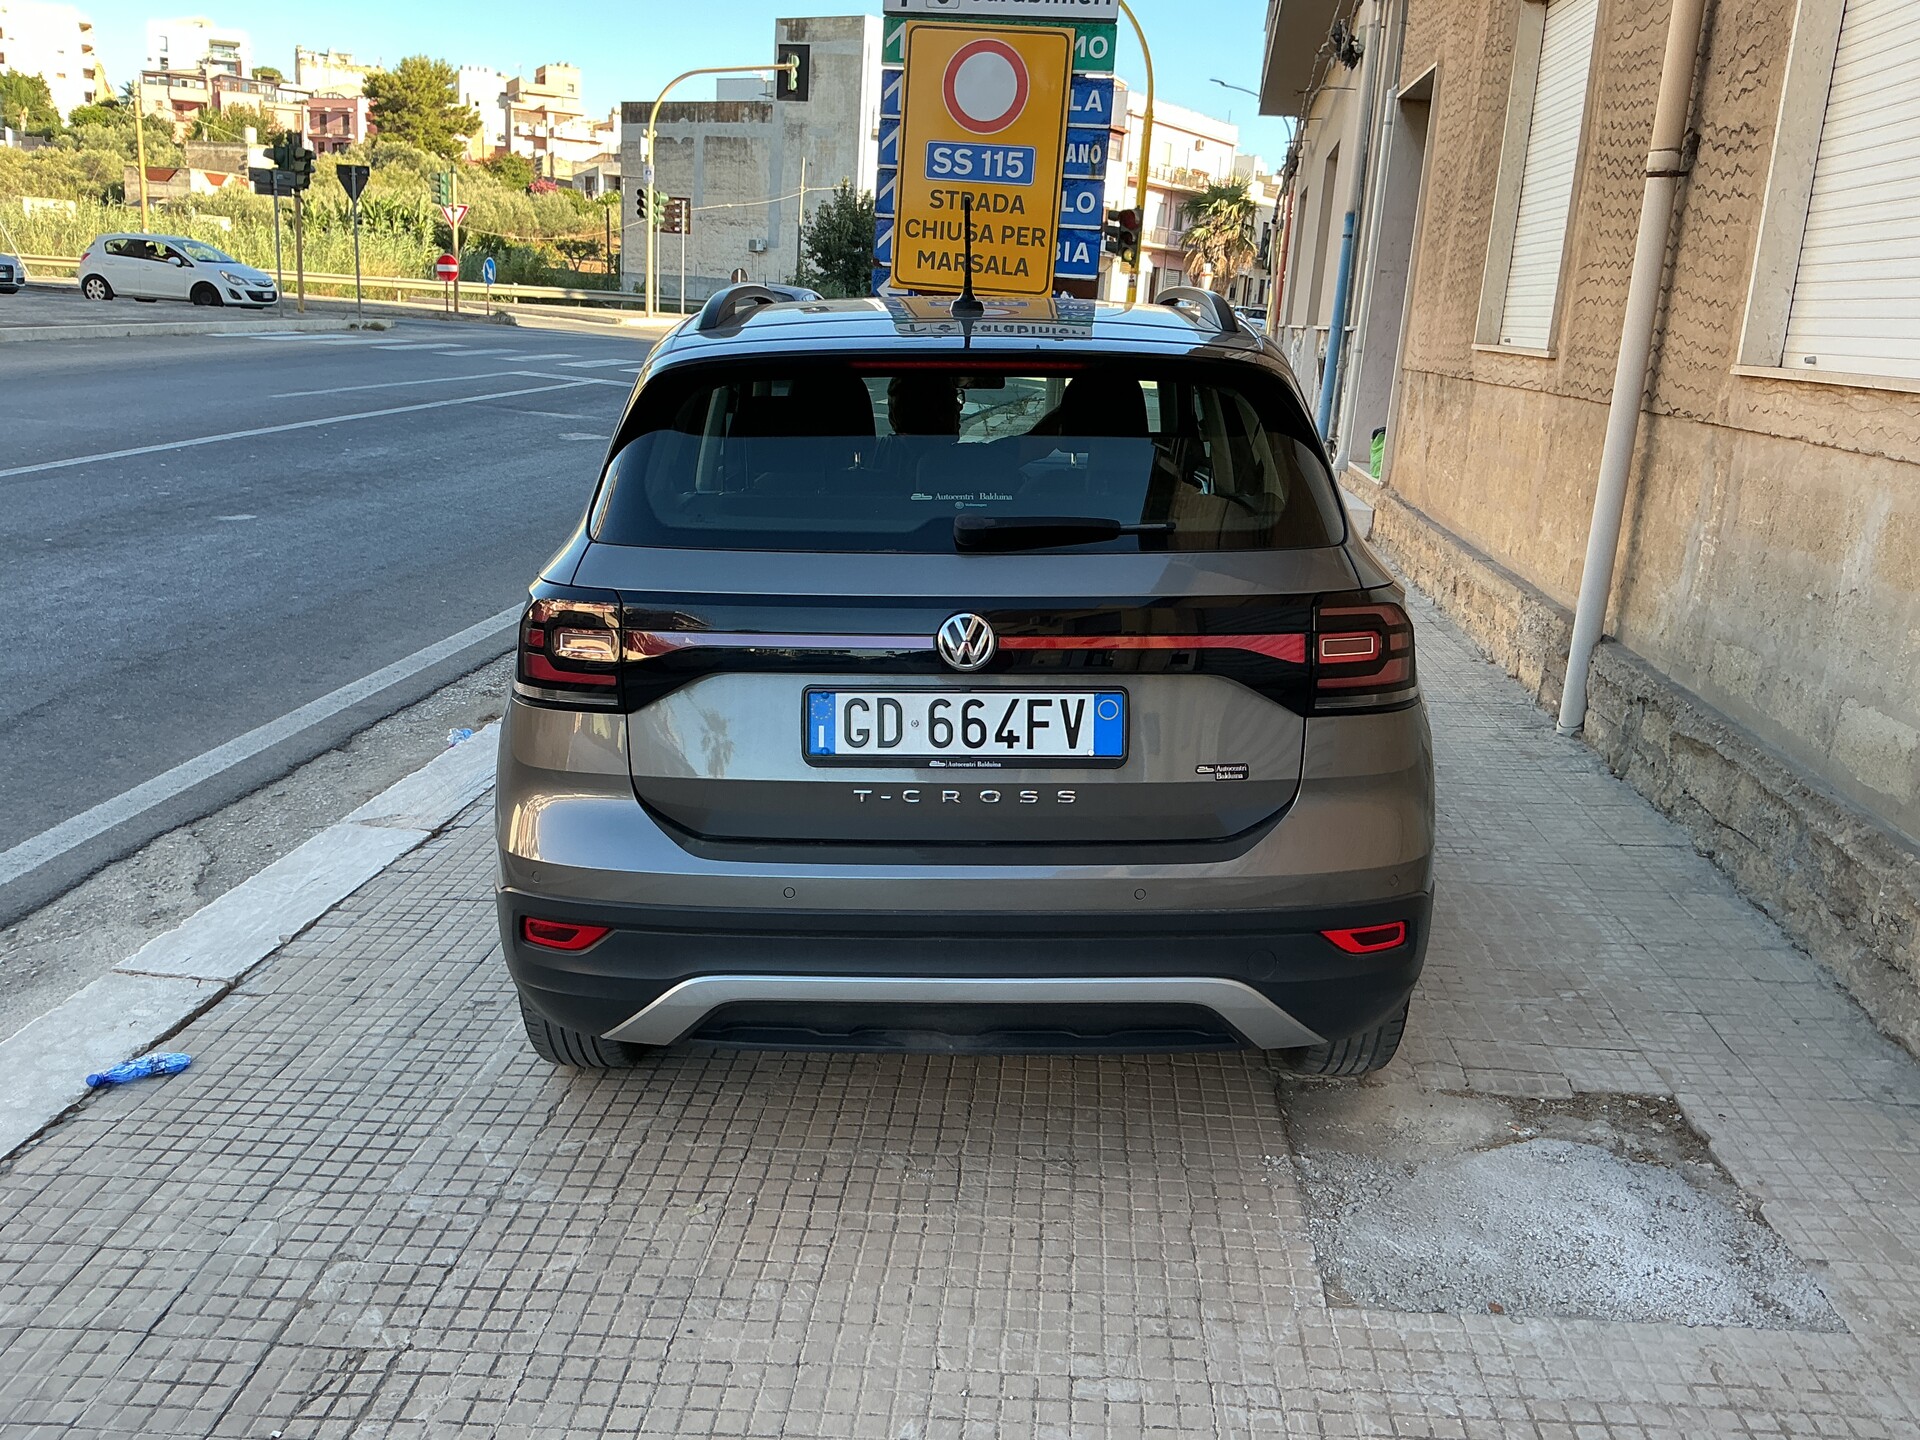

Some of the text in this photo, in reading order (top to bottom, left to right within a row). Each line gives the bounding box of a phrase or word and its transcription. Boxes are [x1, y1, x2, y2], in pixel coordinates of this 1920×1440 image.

[1069, 88, 1103, 112] LA
[932, 147, 1024, 178] SS 115
[1066, 143, 1102, 164] ANO
[929, 189, 1025, 215] STRADA
[1060, 190, 1096, 214] LO
[905, 218, 1046, 248] CHIUSA PER
[917, 249, 1029, 277] MARSALA
[935, 492, 974, 500] Autocentri
[979, 492, 1013, 500] Balduina
[844, 697, 1086, 750] GD 664FV
[853, 789, 1077, 804] T-CROSS
